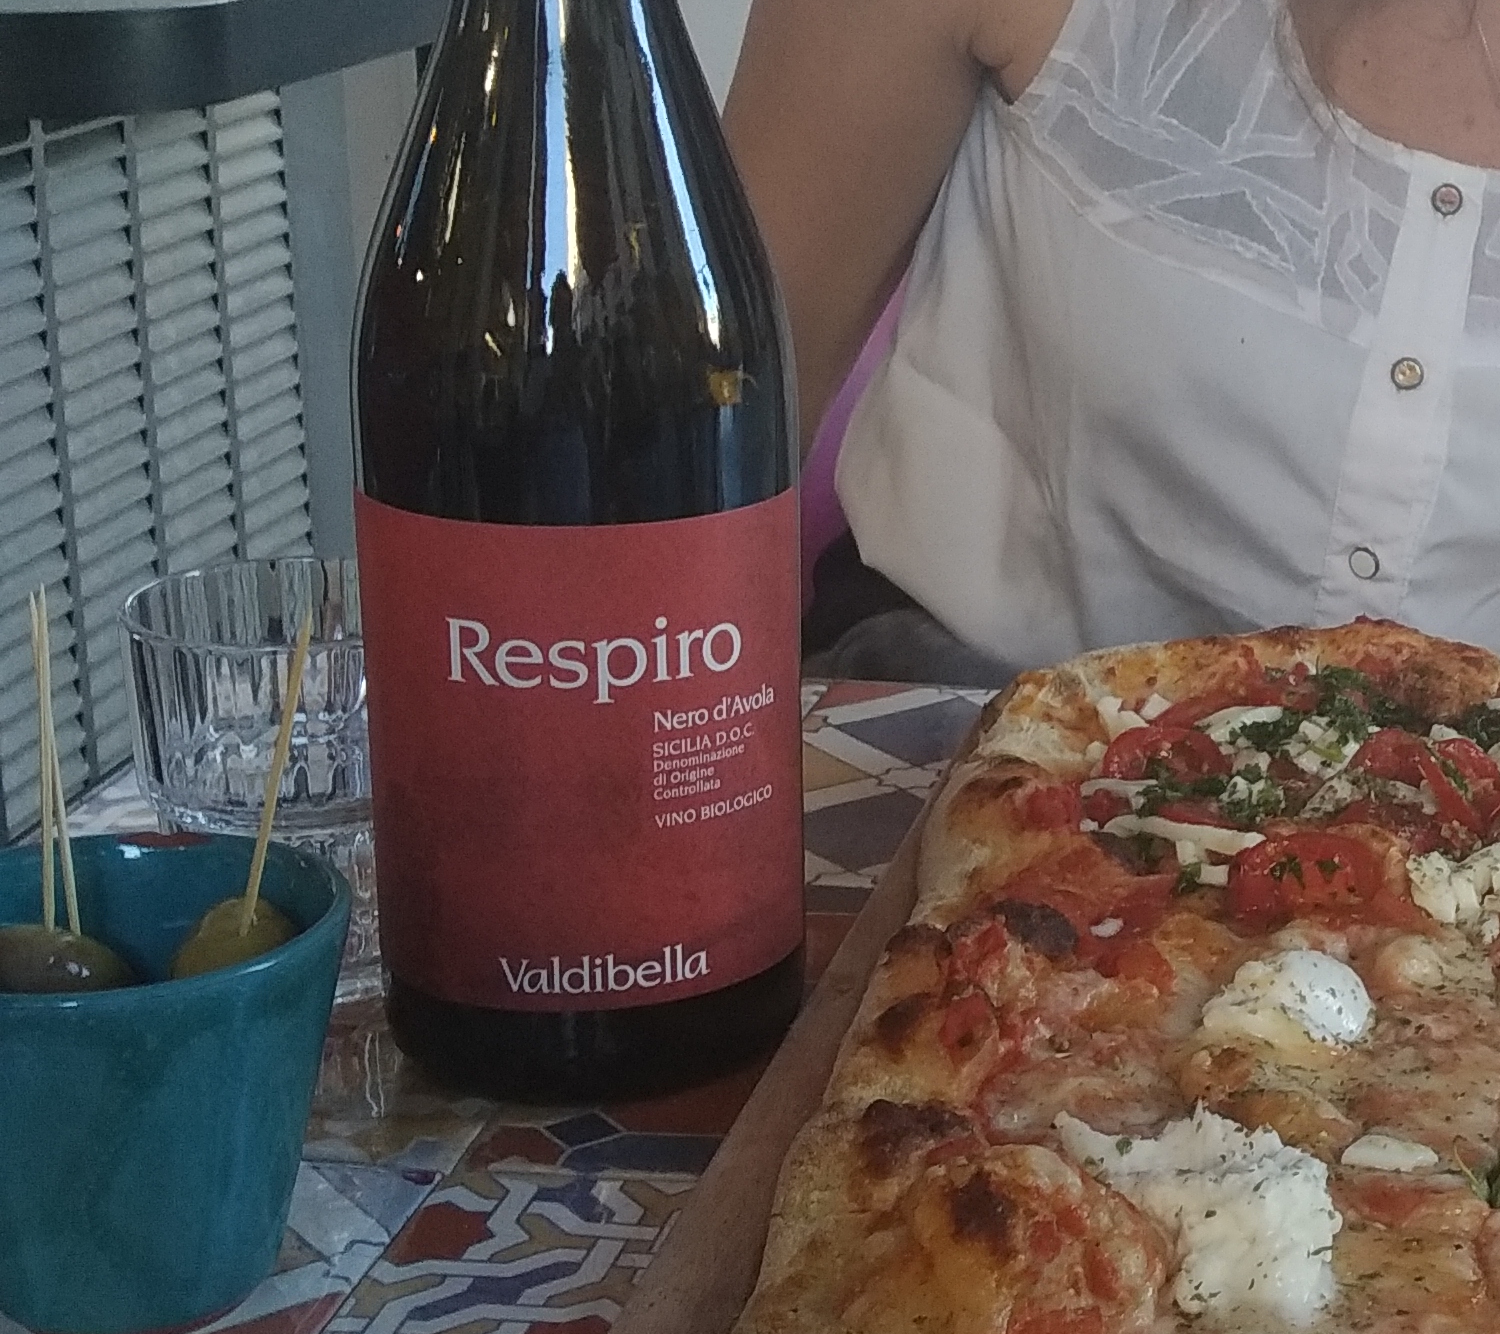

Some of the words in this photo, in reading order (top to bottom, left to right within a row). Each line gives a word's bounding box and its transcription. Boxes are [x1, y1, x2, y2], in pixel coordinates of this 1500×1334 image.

[445, 616, 742, 705] Respiro
[653, 708, 709, 733] Nero
[713, 682, 775, 721] d'Avola
[652, 734, 712, 758] SICILIA
[653, 743, 745, 773] Denominazione
[653, 772, 667, 786] di
[670, 766, 715, 784] Origine
[653, 778, 721, 801] Controllata
[654, 808, 697, 829] VINO
[700, 783, 773, 821] BIOLOGICO
[499, 942, 711, 994] Valdibella
